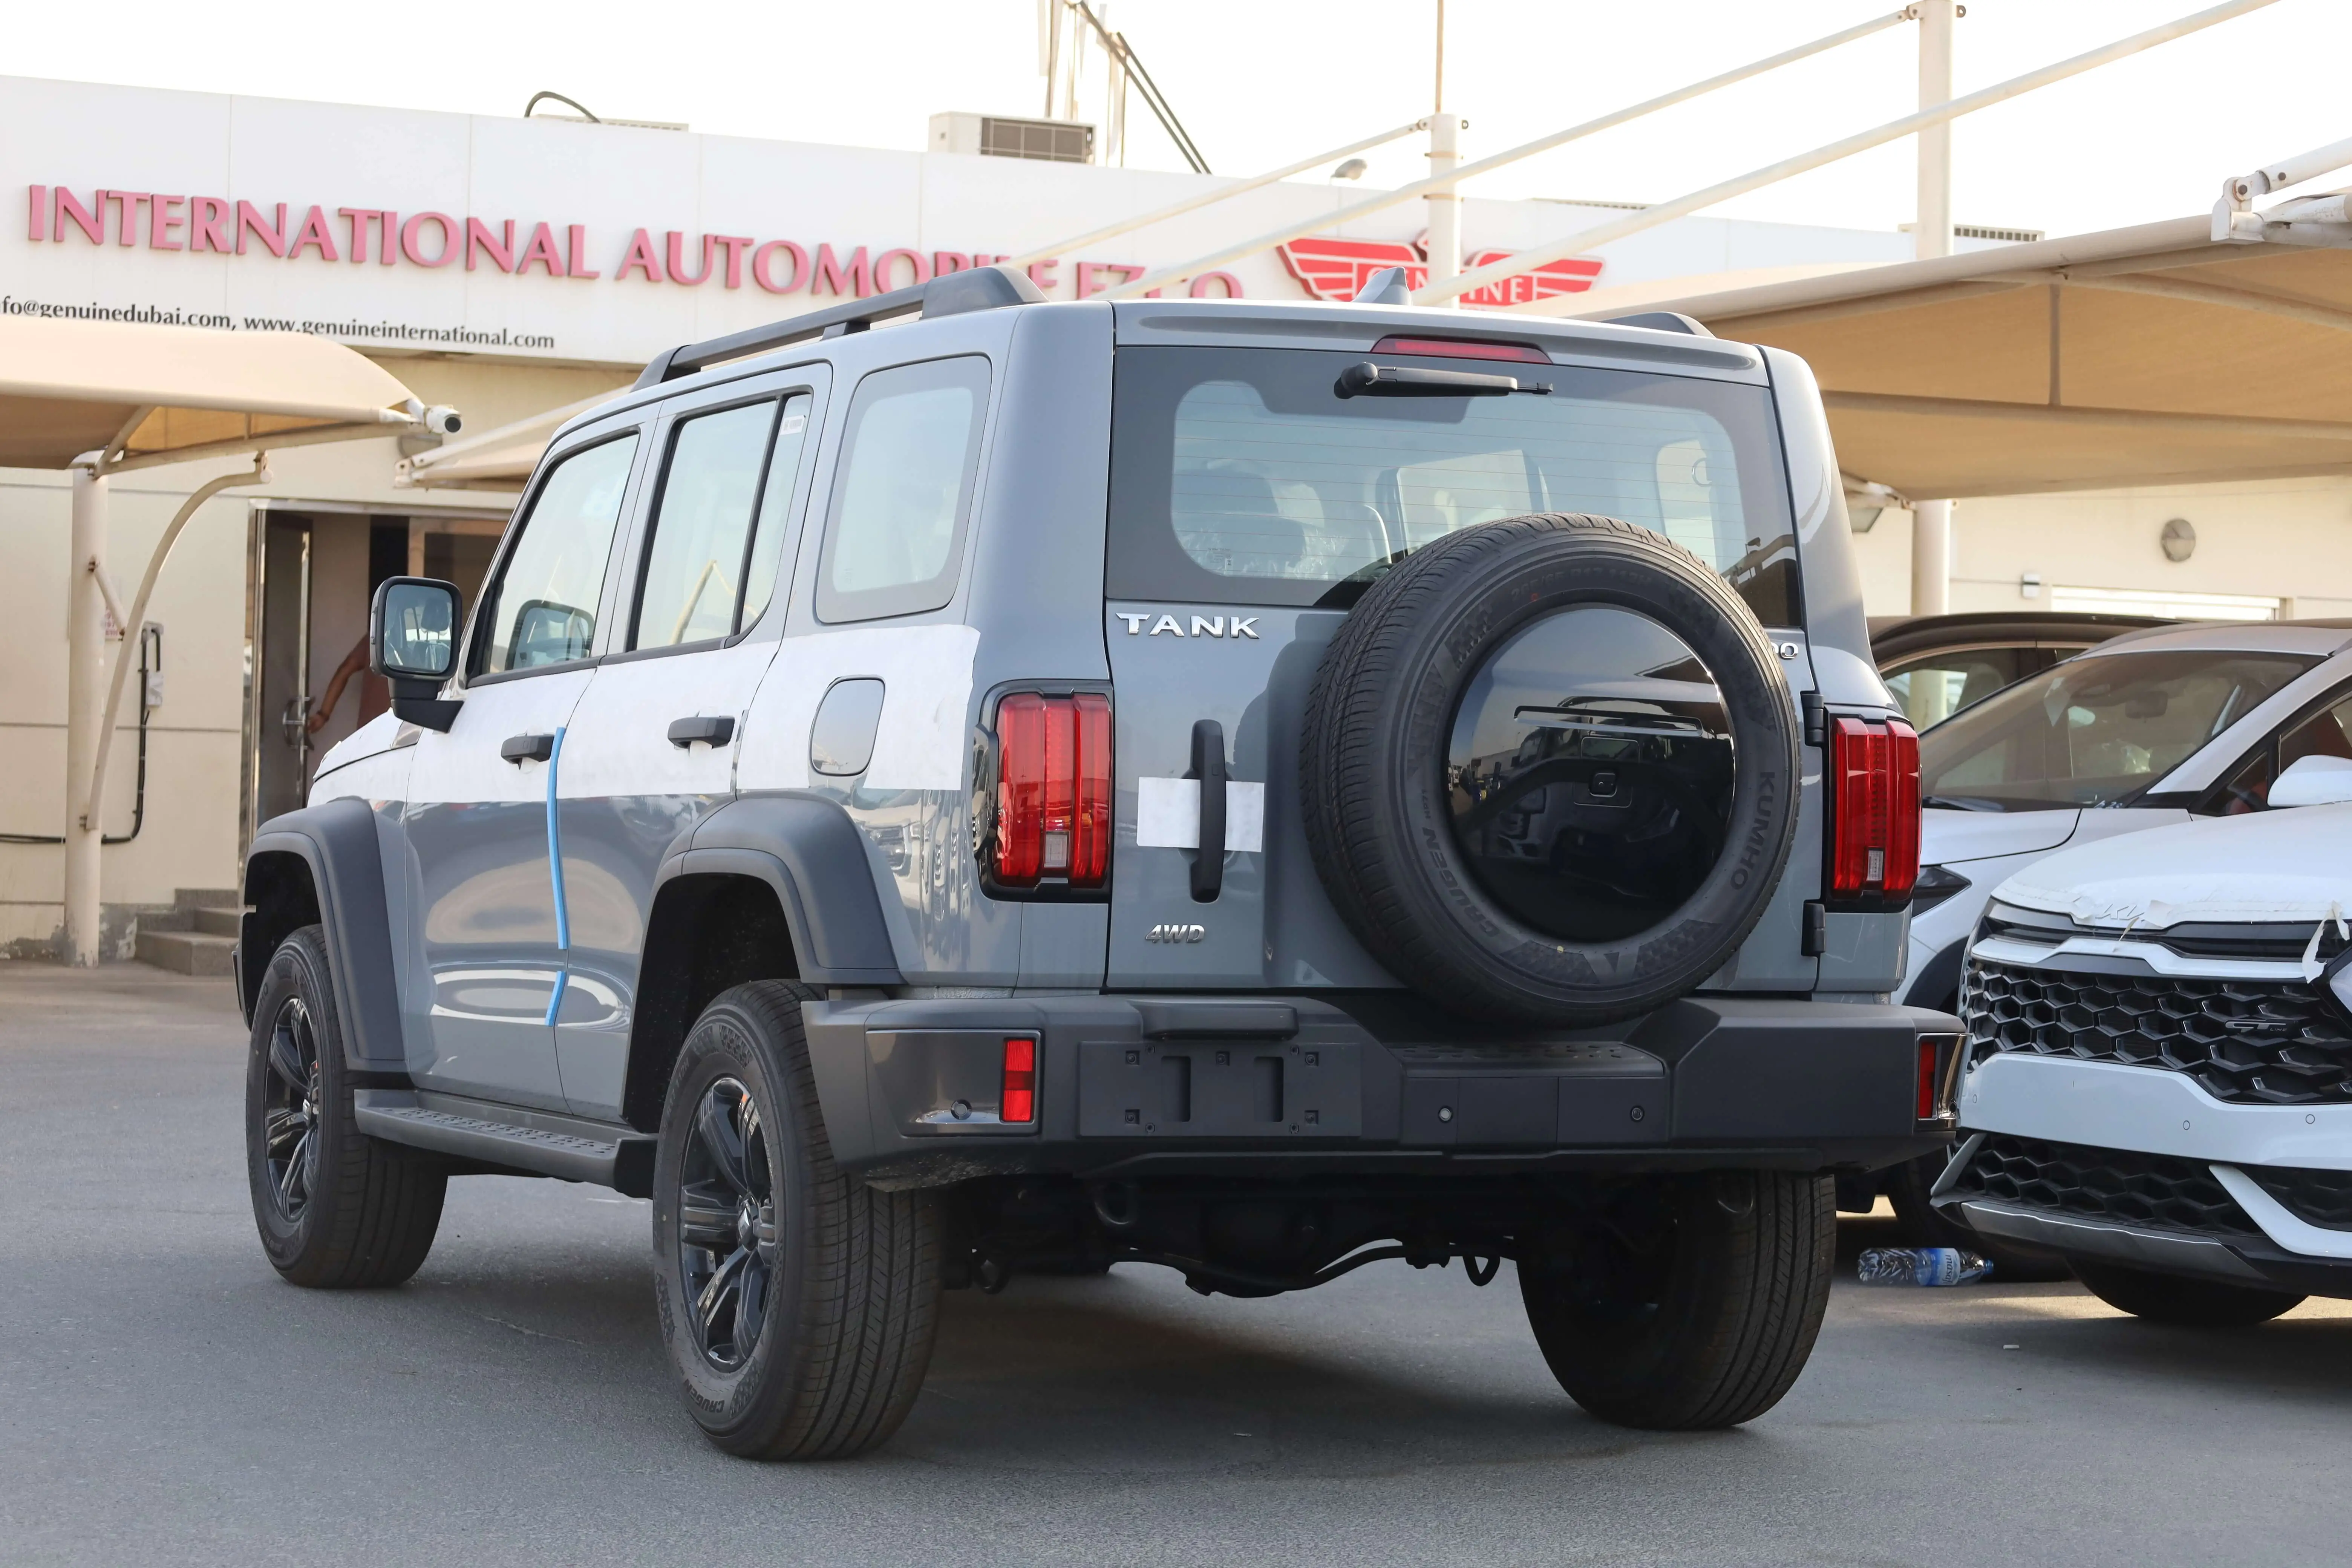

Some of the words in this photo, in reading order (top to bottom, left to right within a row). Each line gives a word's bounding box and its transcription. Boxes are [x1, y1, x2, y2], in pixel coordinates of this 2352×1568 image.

[28, 184, 600, 279] INTERNATIONAL
[615, 228, 1059, 298] AUTOMOE
[244, 317, 554, 349] www.genuineinternational.com
[1116, 612, 1260, 639] TANK
[1730, 771, 1775, 890] KUMHO
[1422, 827, 1501, 937] CRUGEN
[1145, 925, 1205, 943] 4WD
[2225, 1021, 2286, 1033] GT
[683, 1378, 725, 1413] CRUGEN
